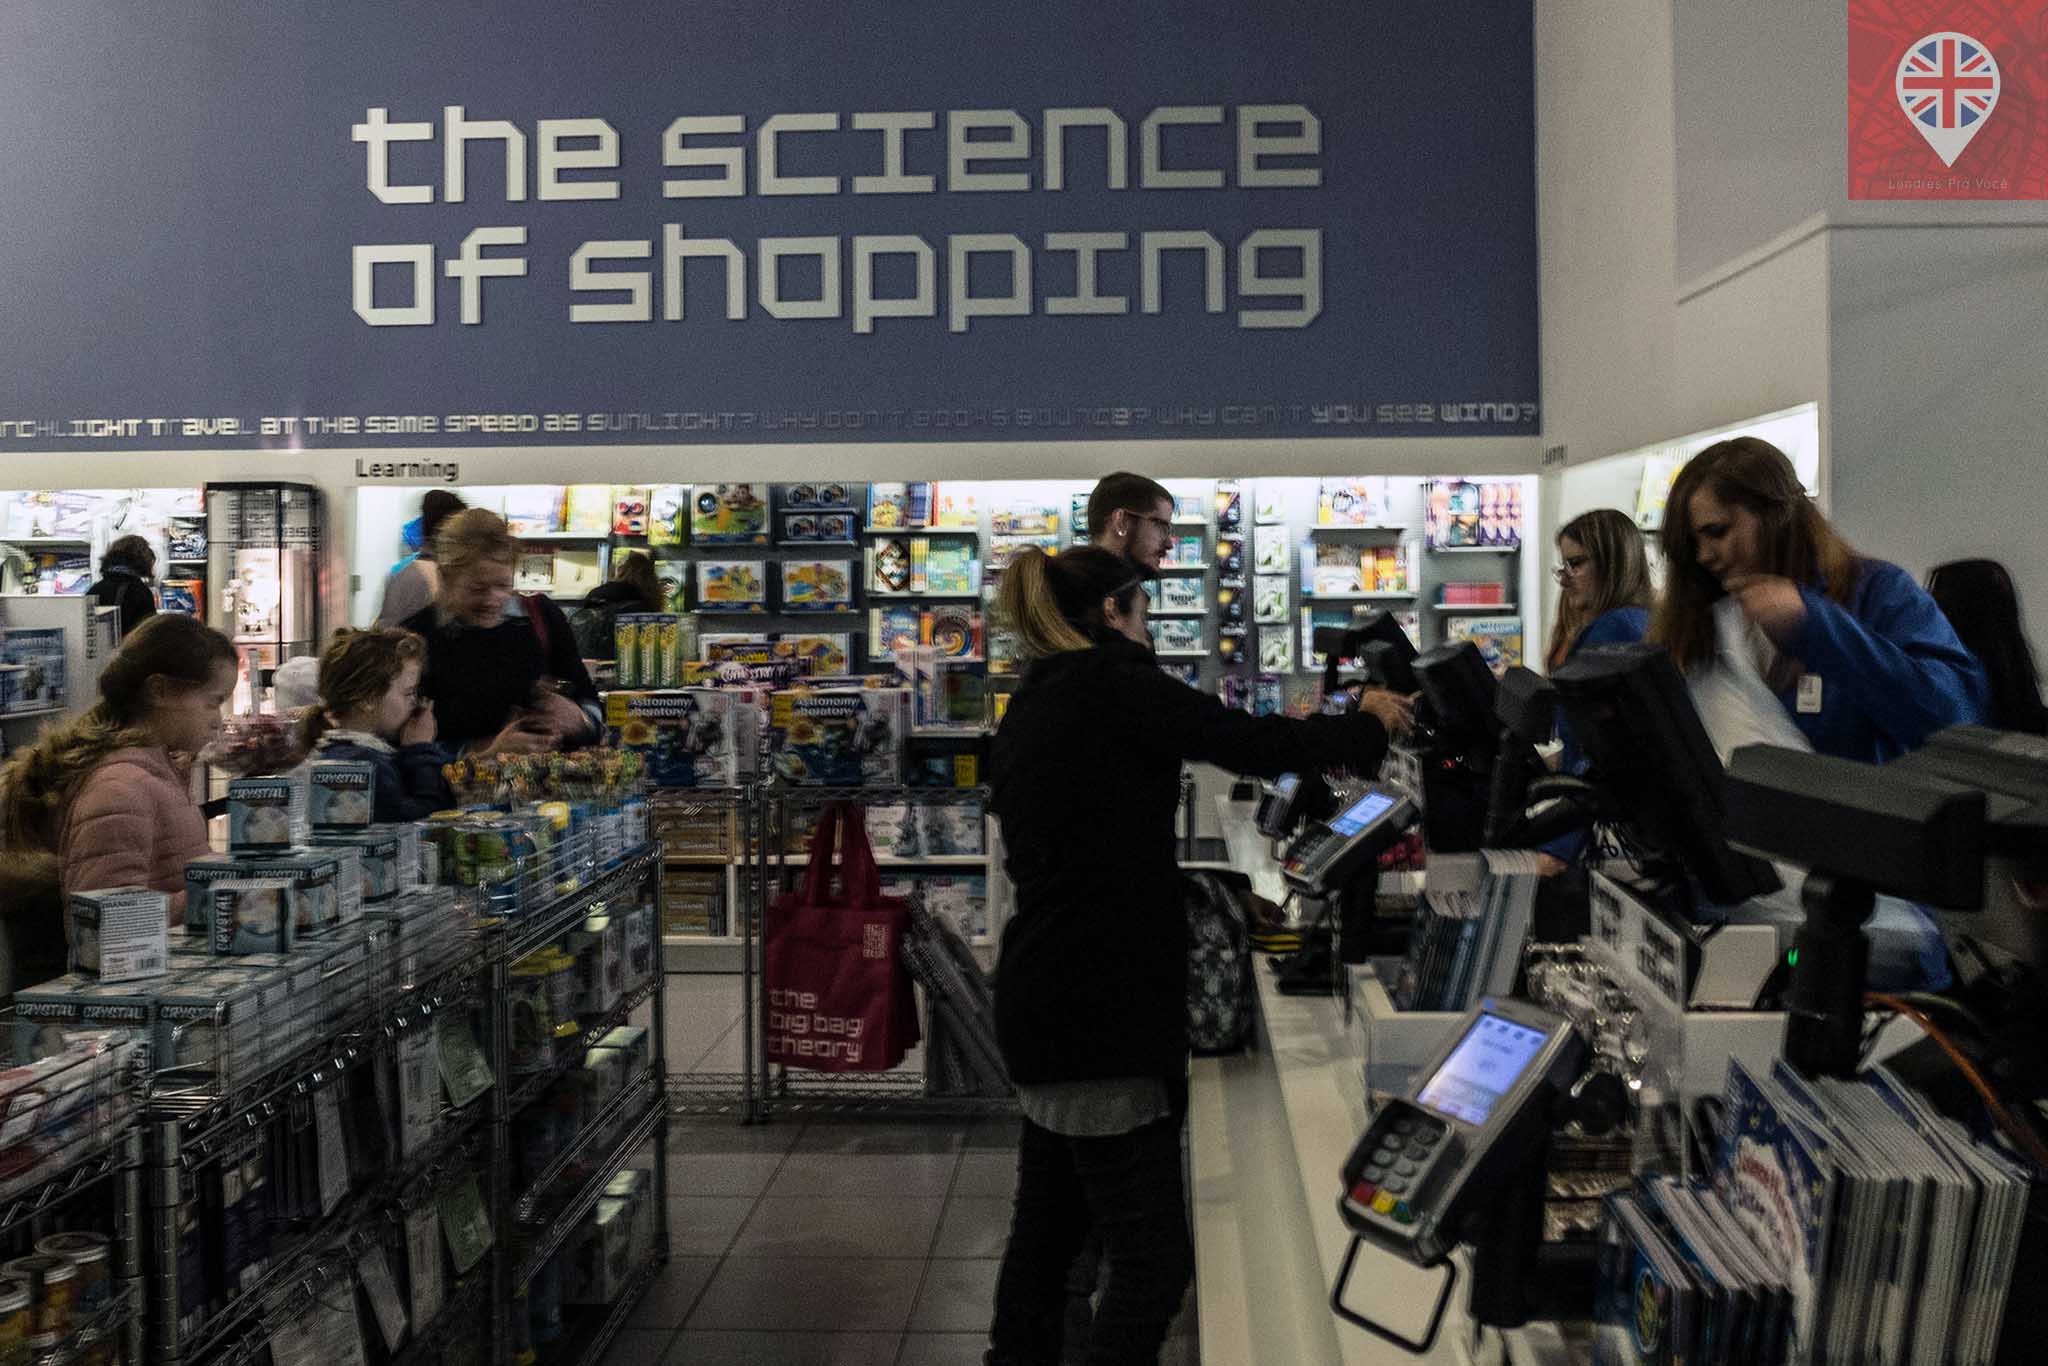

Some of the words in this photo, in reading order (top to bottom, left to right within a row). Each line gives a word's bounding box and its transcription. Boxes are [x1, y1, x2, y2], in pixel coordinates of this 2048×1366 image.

[351, 105, 620, 204] the
[351, 225, 527, 327] of
[569, 223, 1325, 334] shopping
[356, 457, 460, 482] Learning
[312, 772, 368, 784] CRYSTAL
[230, 787, 289, 799] CRYSTAL
[215, 892, 238, 952] CRYSTAL
[16, 1002, 80, 1017] CRYSTAL
[769, 988, 818, 1009] the
[83, 1005, 145, 1019] CRYSTAL
[812, 1013, 864, 1039] bag
[766, 1035, 864, 1063] theory
